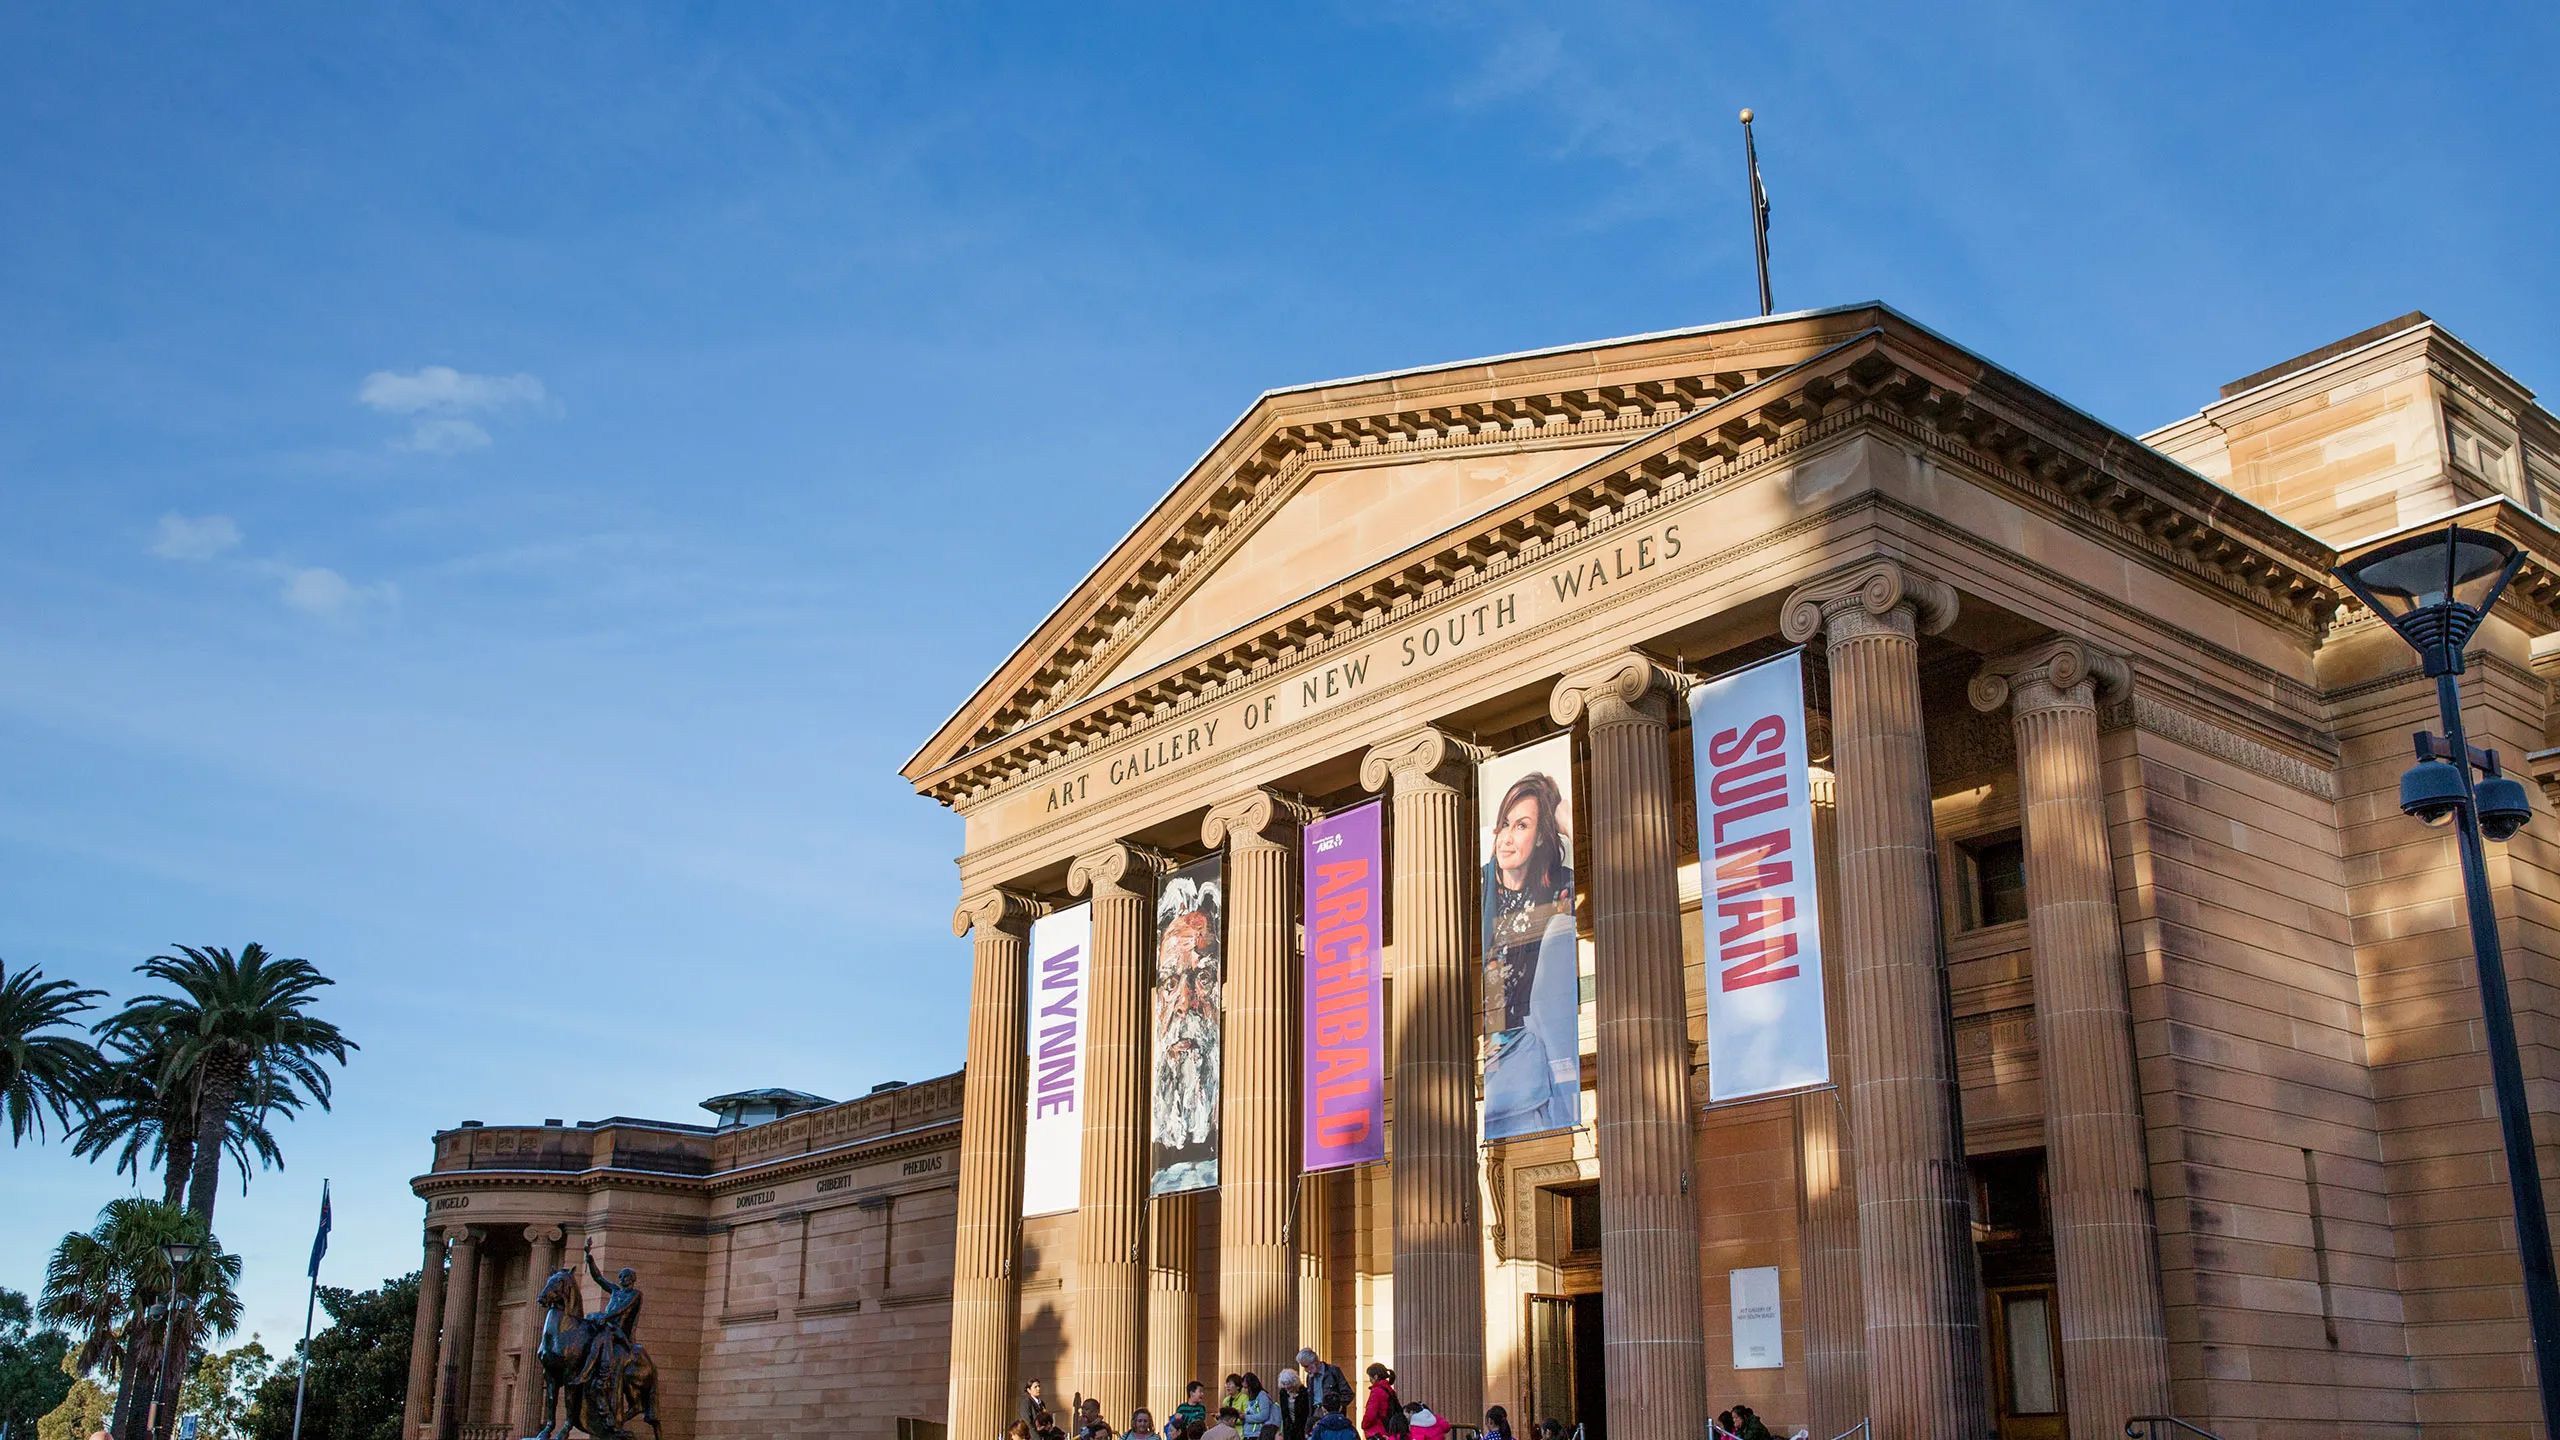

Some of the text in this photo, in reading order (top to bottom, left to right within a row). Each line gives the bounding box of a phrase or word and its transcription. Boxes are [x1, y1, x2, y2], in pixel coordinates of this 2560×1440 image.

[1046, 524, 1682, 812] ART GALLERY OF NEW SOUTH WALES
[1709, 714, 1800, 993] SULMAN
[1036, 944, 1080, 1120] WYNNE
[1315, 857, 1370, 1149] ARCHIBALD
[435, 1196, 469, 1210] ANGELO
[736, 1190, 776, 1209] DONATELLO
[816, 1174, 852, 1193] GHIBERTI
[903, 1156, 942, 1176] PHEIDIAS
